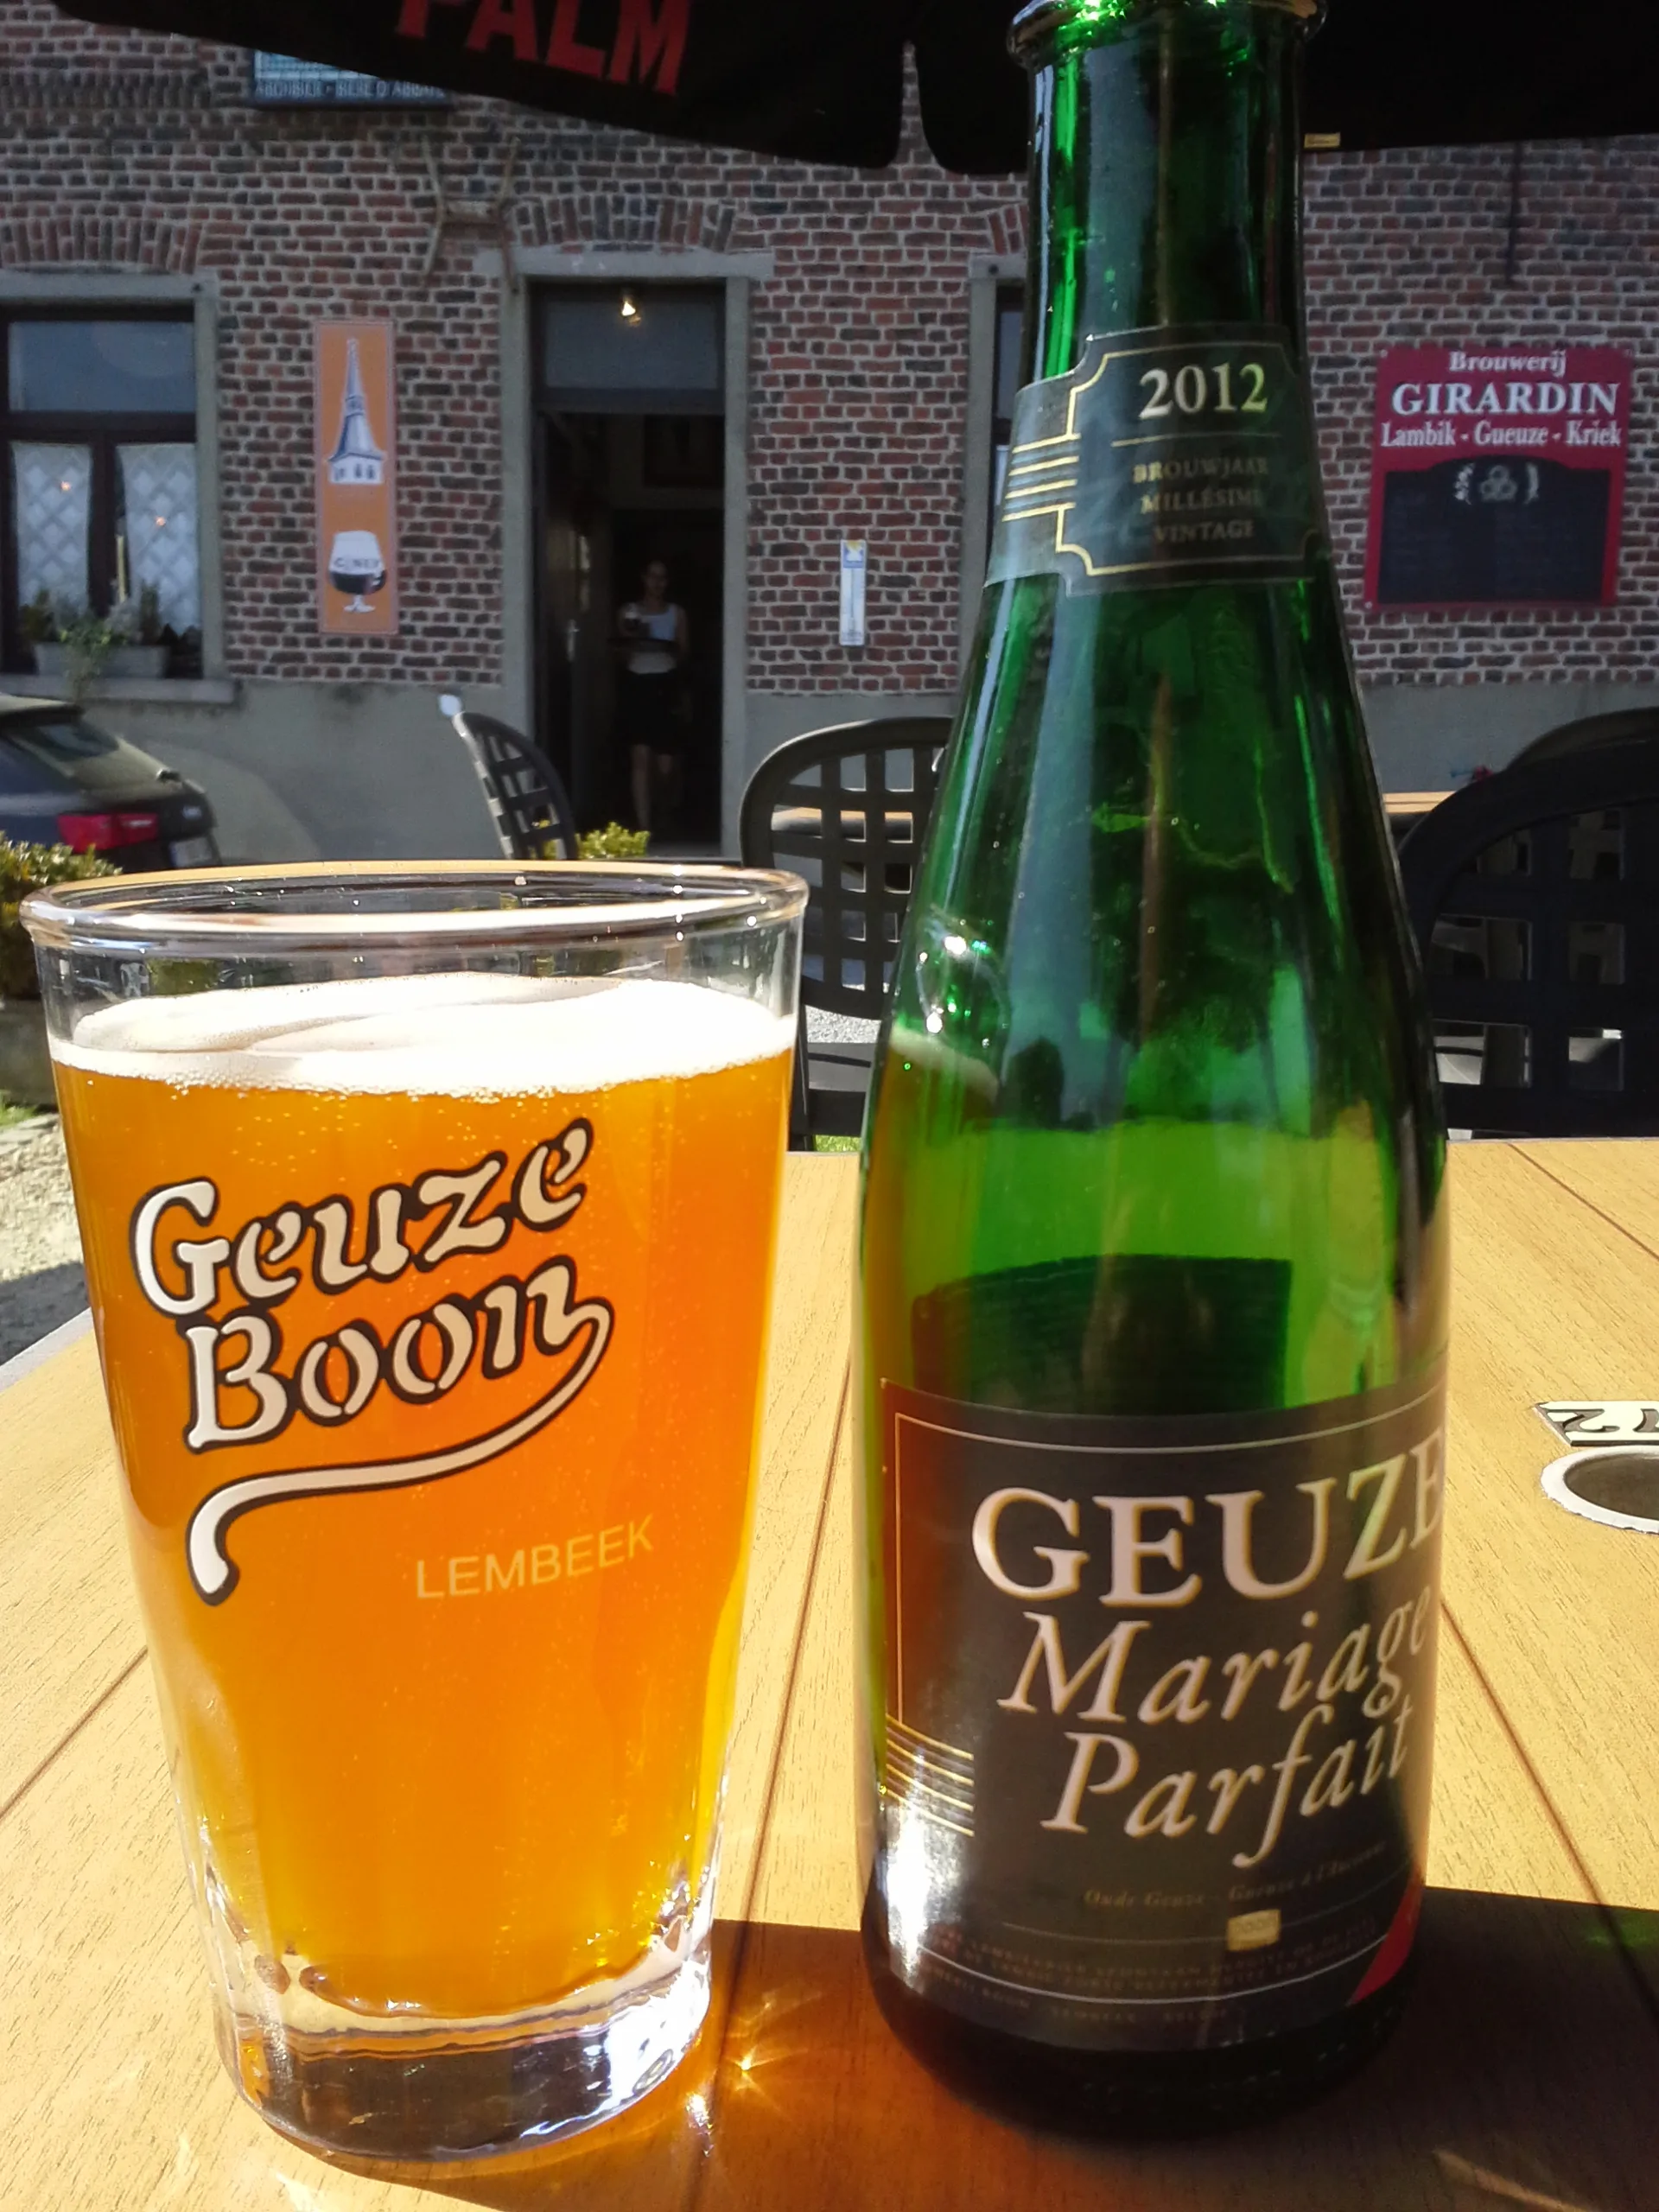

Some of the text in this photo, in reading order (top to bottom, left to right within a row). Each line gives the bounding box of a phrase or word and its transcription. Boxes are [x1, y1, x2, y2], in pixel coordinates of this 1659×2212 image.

[1138, 362, 1268, 420] 2012
[1391, 382, 1619, 416] GIRARDIN
[1449, 350, 1567, 378] Brouwerij
[1381, 421, 1457, 447] Lambik
[1566, 419, 1622, 446] Kriek
[129, 1116, 594, 1317] Geuze
[182, 1254, 615, 1457] Boon
[416, 1515, 655, 1599] LEMBEEK
[971, 1427, 1446, 1607] GEUZE
[996, 1585, 1431, 1725] Mariage
[1039, 1694, 1414, 1869] Parfait
